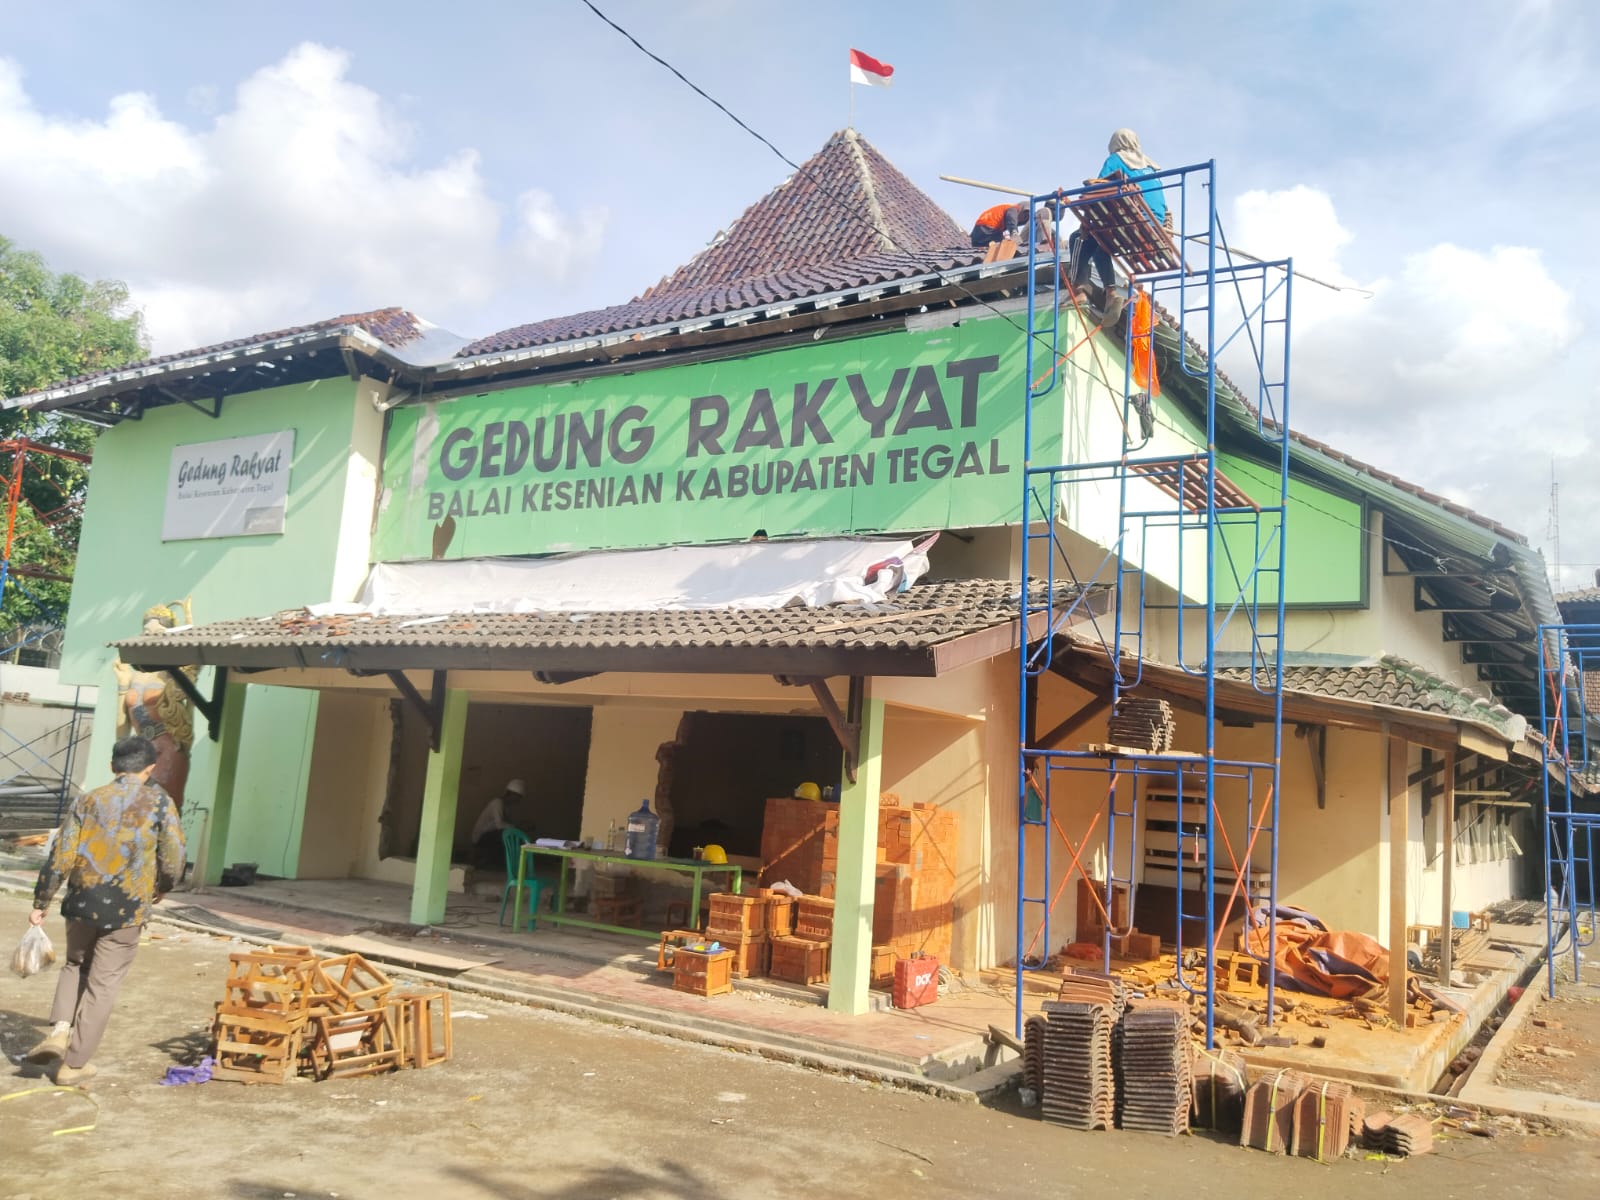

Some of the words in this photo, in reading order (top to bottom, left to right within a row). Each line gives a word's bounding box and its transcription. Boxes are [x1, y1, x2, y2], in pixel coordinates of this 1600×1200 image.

[440, 405, 655, 481] GEDUNG
[686, 354, 1000, 458] RAKYAT
[178, 457, 227, 488] Gedung
[230, 449, 281, 480] Rakyat
[427, 485, 513, 520] BALAI
[522, 473, 663, 514] KESENIAN
[676, 453, 875, 502] KABUPATEN
[886, 440, 1010, 485] TEGAL
